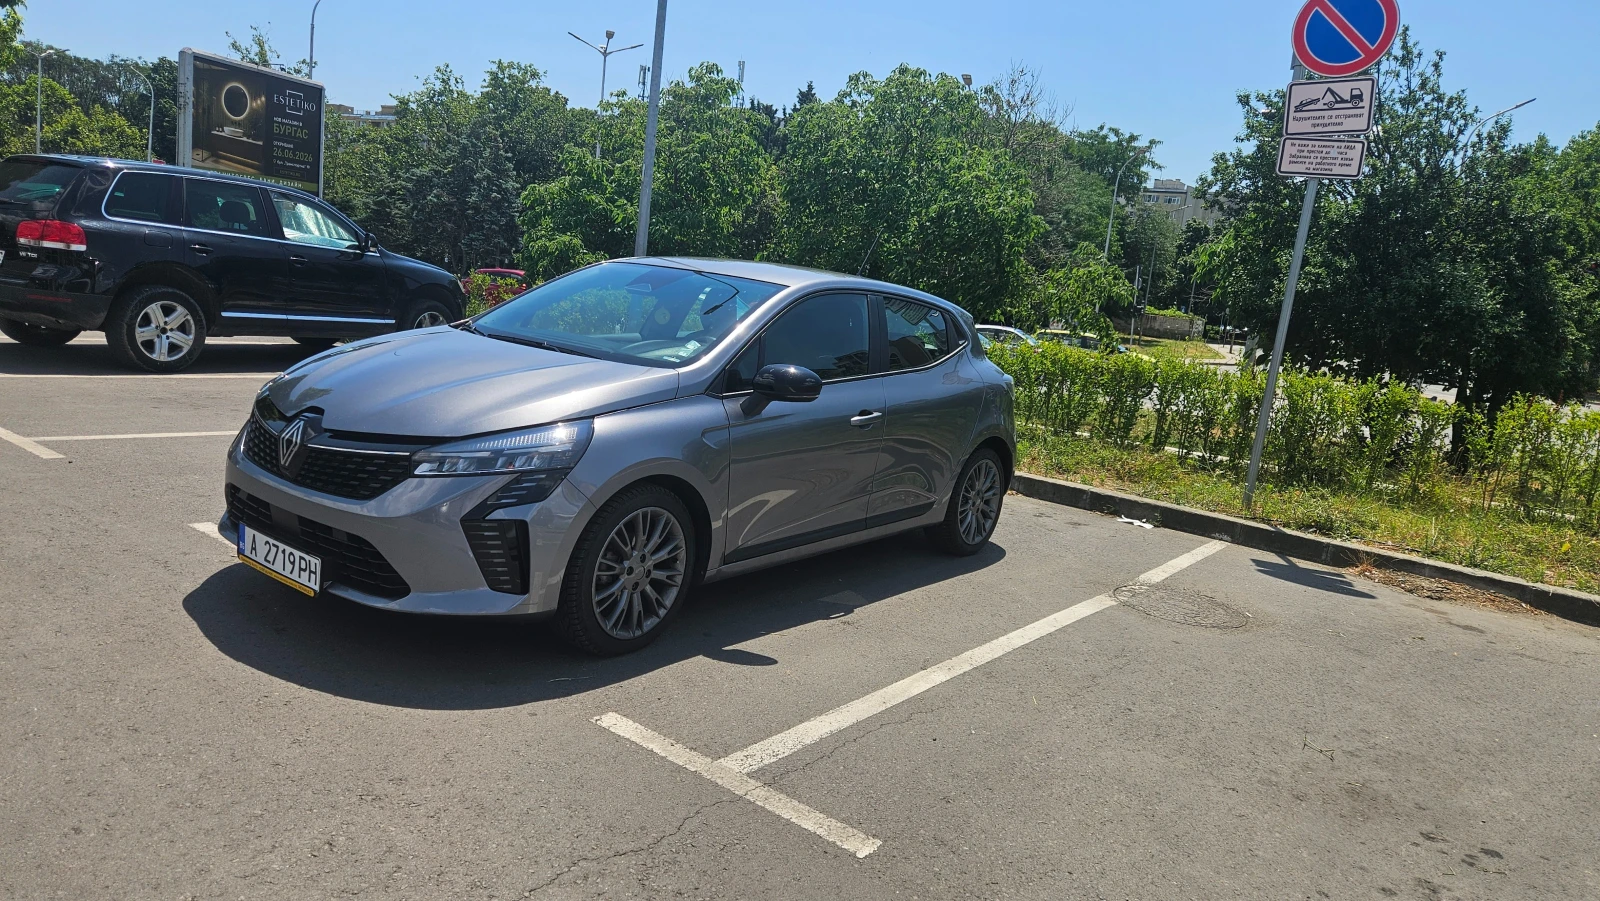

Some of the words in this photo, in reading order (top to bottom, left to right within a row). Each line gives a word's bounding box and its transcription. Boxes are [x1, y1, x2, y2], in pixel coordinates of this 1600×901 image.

[274, 94, 316, 111] ESTETIKO
[282, 118, 299, 126] МАГАЗИН
[1292, 115, 1325, 123] Нарушителите
[1310, 121, 1344, 129] принудително
[273, 123, 308, 139] БУРГАС
[273, 147, 313, 162] 26.06.2026
[250, 533, 258, 558] A
